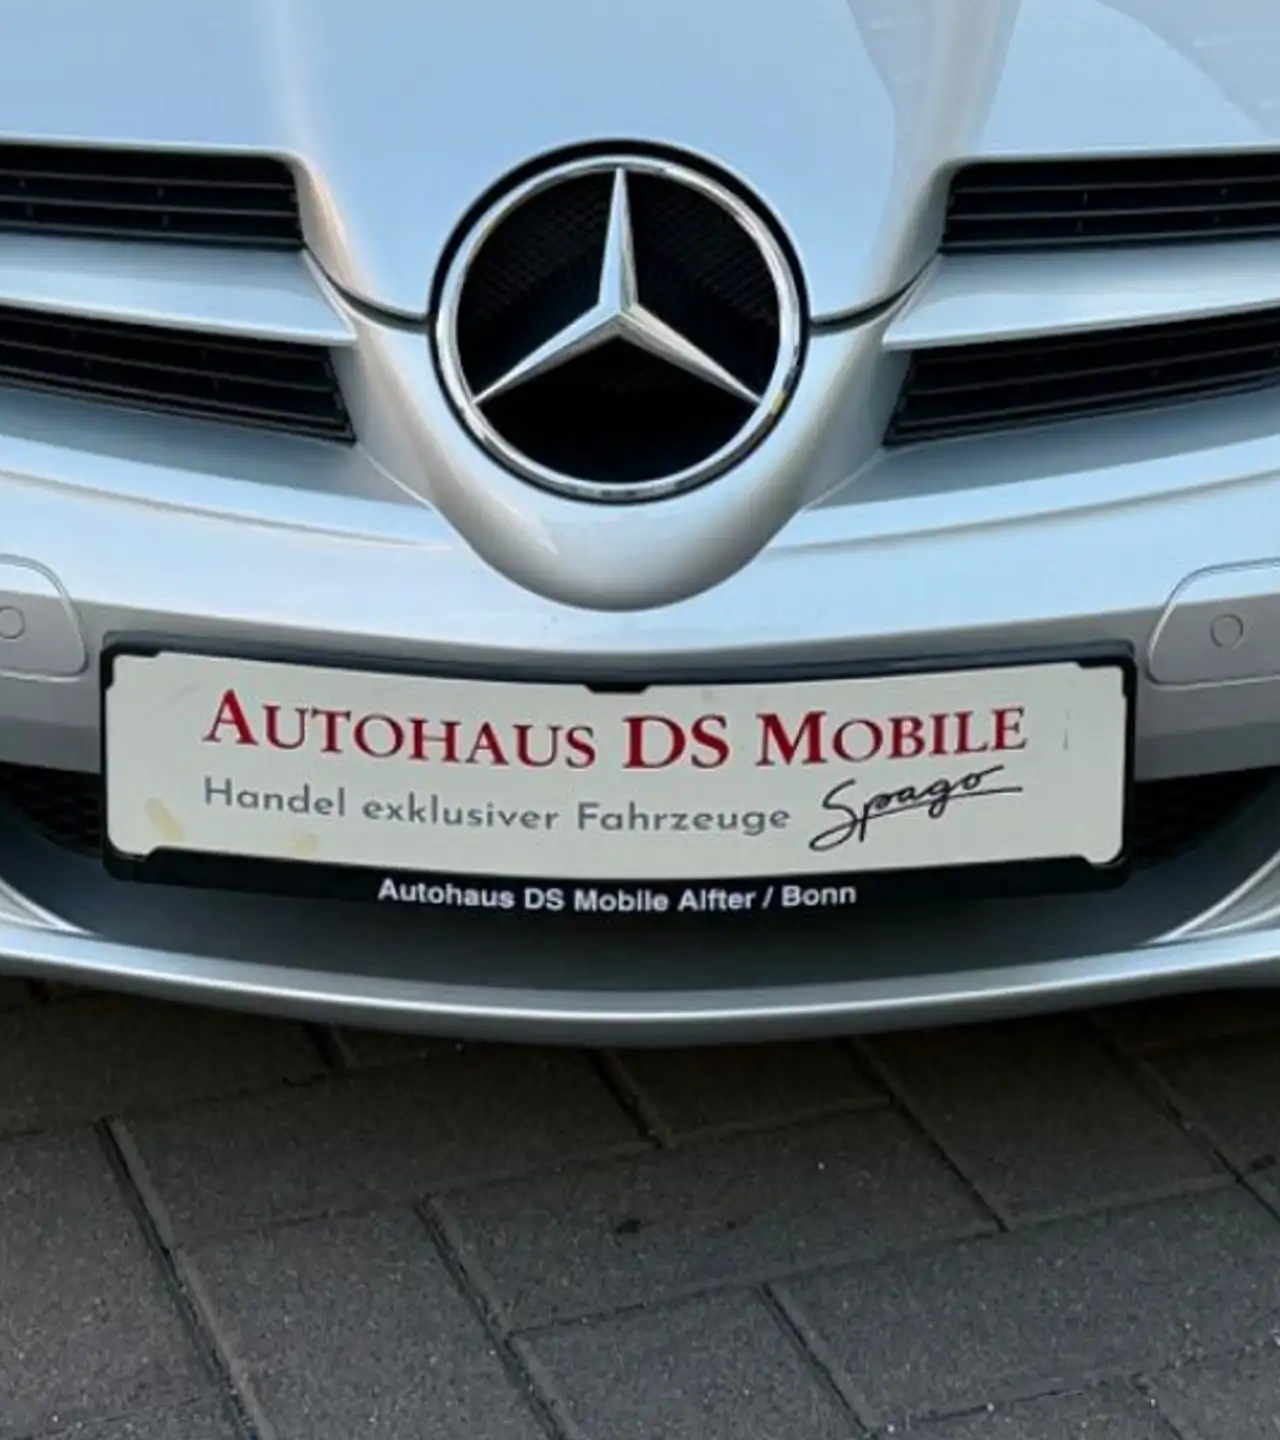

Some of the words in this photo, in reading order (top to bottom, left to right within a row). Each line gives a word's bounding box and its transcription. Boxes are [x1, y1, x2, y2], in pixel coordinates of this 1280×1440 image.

[202, 688, 597, 769] AUTOHAUS
[623, 714, 730, 769] DS
[755, 707, 1026, 767] MOBILE
[204, 776, 346, 817] Handel
[362, 791, 560, 831] exklusiver
[577, 801, 791, 837] Fahrzeuge
[808, 764, 1023, 852] Spago
[378, 878, 515, 909] Autohaus
[524, 888, 564, 911] DS
[574, 889, 669, 912] Mobile
[677, 887, 752, 911] Alfter
[762, 887, 774, 910] /
[781, 885, 857, 908] Bonn
